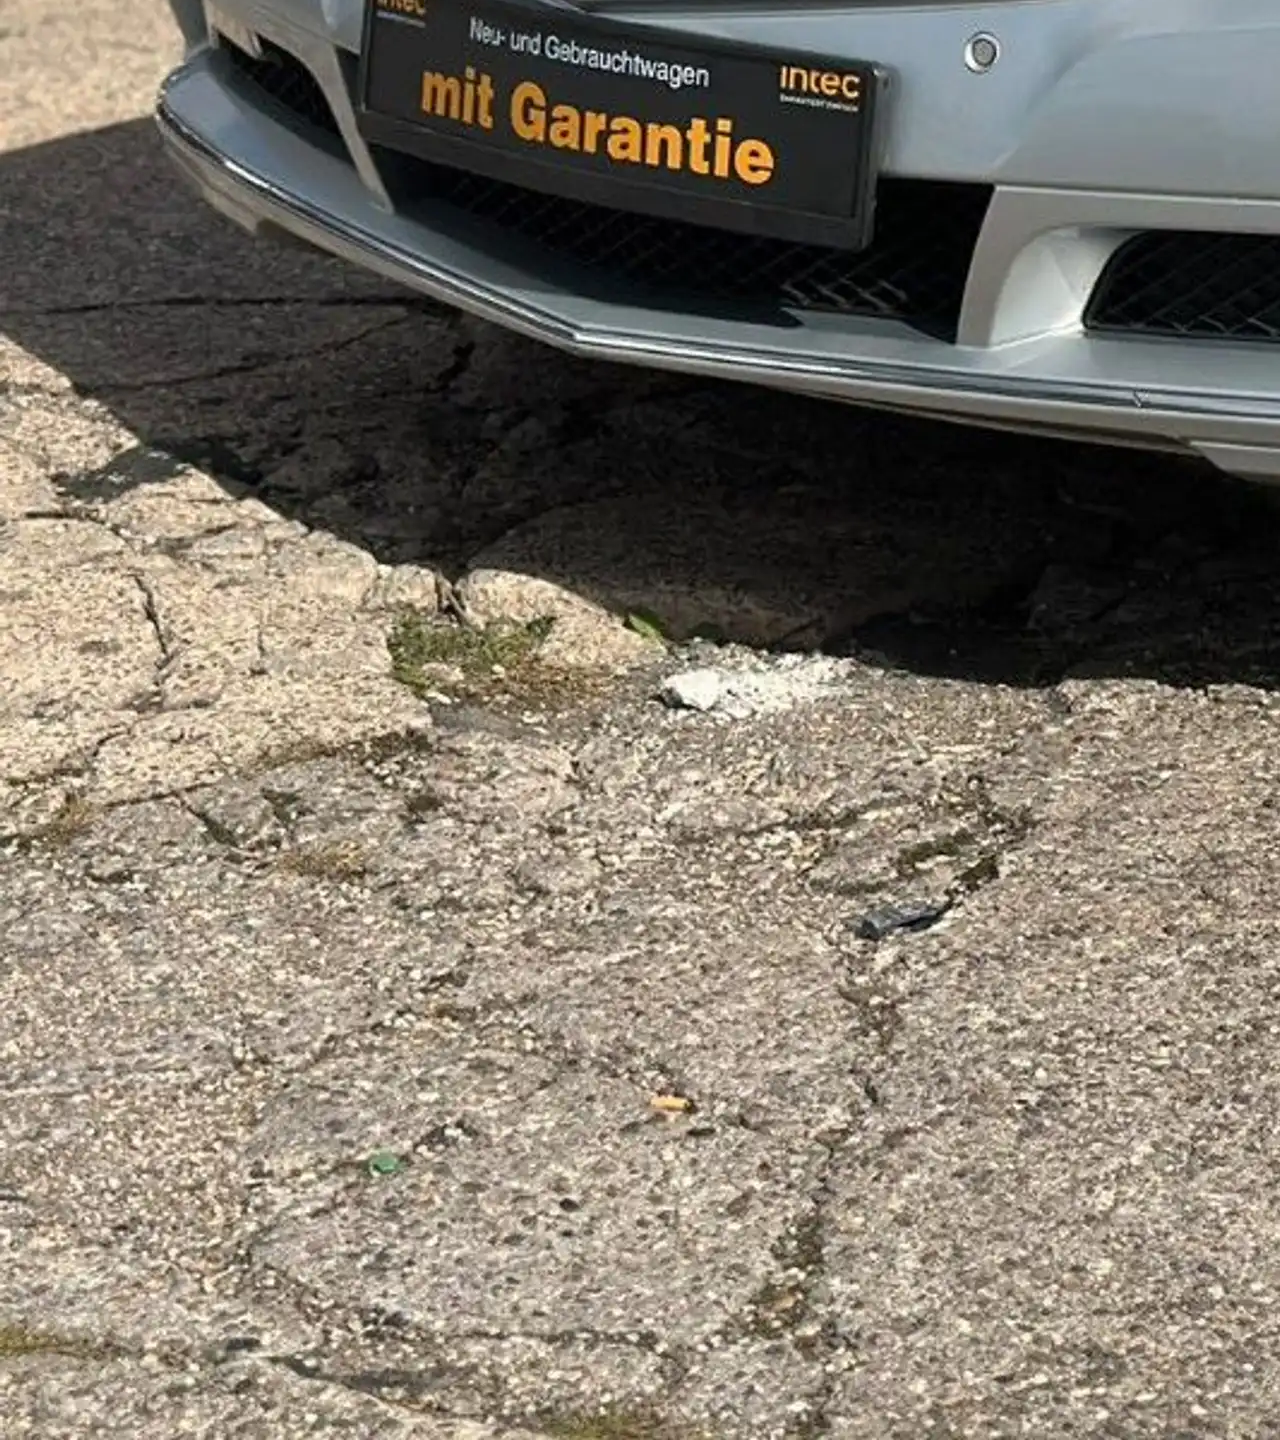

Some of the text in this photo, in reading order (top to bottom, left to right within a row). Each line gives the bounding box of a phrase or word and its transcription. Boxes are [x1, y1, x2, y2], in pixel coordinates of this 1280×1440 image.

[470, 16, 710, 89] Neu- und Gebrauchtwagen
[422, 66, 774, 185] mit Garantie
